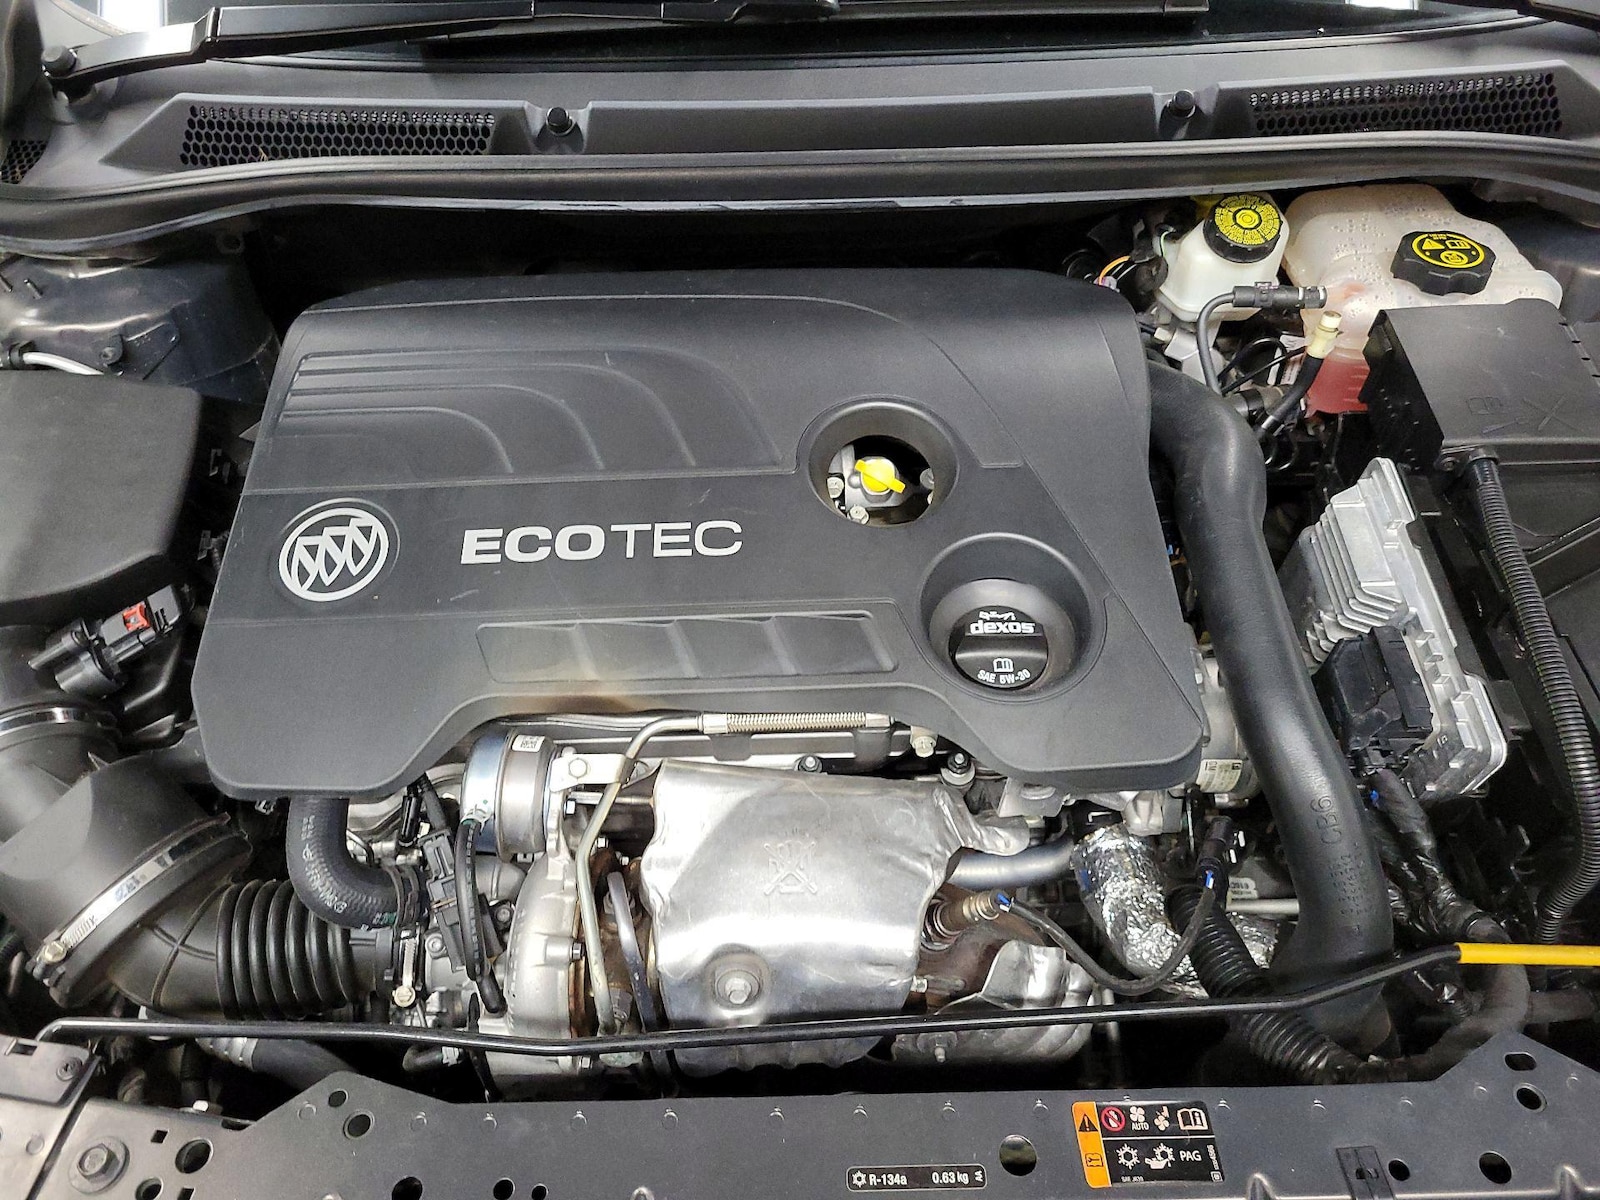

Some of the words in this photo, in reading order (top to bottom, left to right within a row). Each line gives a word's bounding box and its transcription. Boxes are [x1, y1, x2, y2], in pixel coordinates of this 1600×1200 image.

[460, 520, 743, 564] ECOTEC
[969, 619, 1036, 635] dexos
[977, 669, 997, 683] SAE
[1000, 669, 1031, 684] 5W-30
[1131, 1122, 1150, 1131] AUTO
[1179, 1150, 1202, 1162] PAG
[868, 1173, 908, 1186] R-134a
[932, 1171, 956, 1184] 0.63
[956, 1171, 969, 1185] kg
